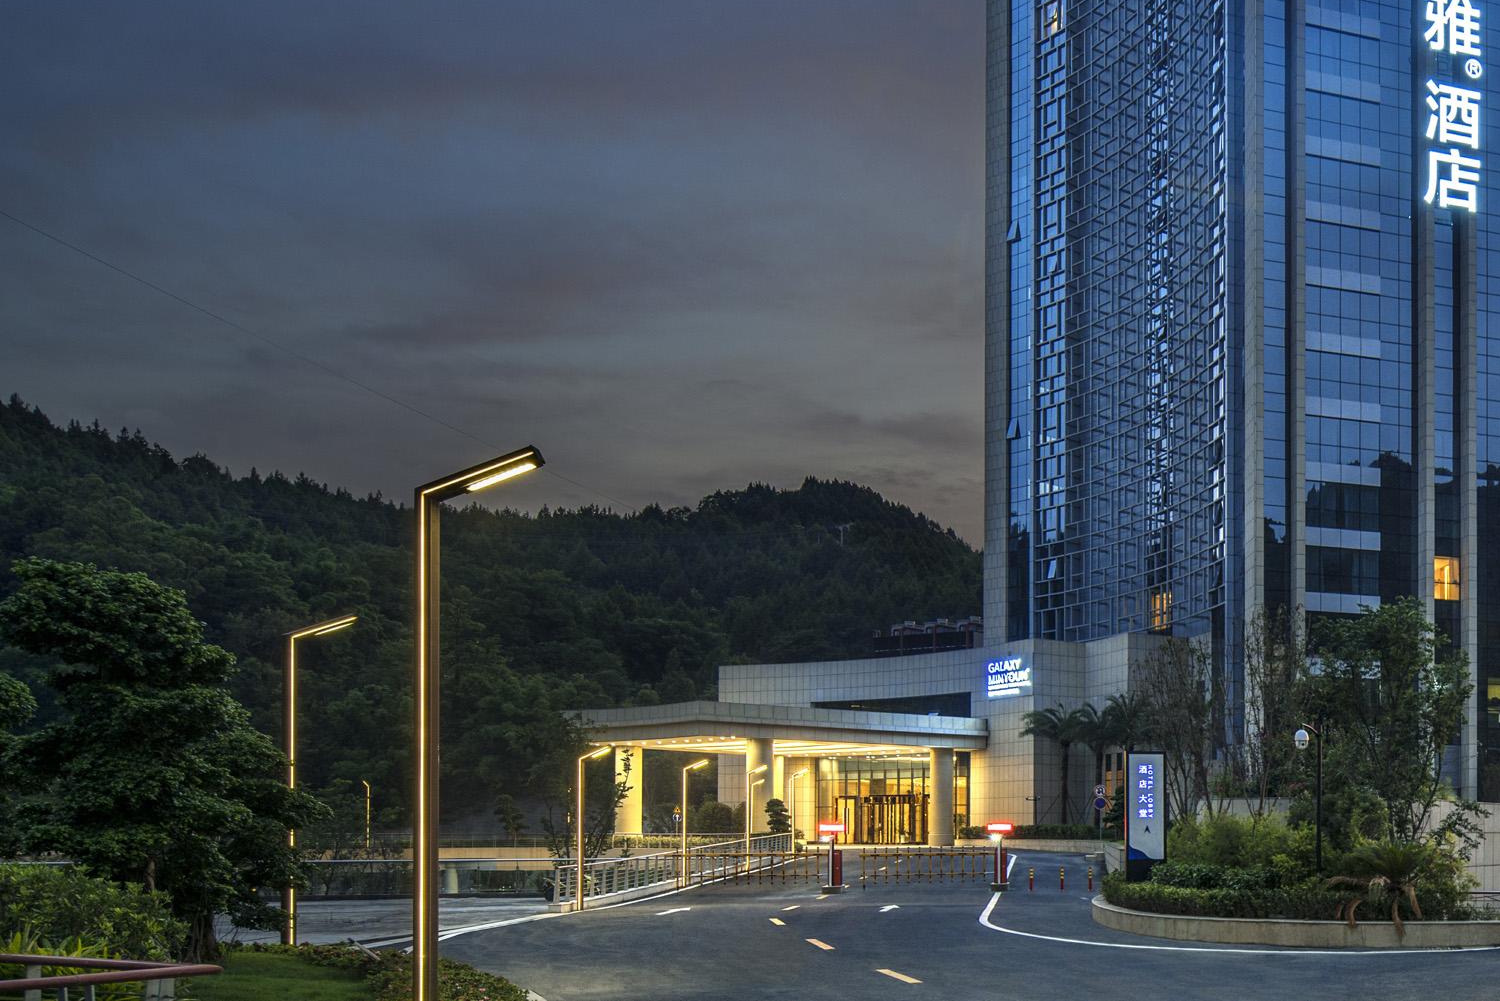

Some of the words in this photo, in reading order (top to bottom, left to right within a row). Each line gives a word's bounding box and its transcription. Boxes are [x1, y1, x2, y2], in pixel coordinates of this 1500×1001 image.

[988, 658, 1021, 673] GALAXY
[1138, 764, 1148, 818] 酒店大堂
